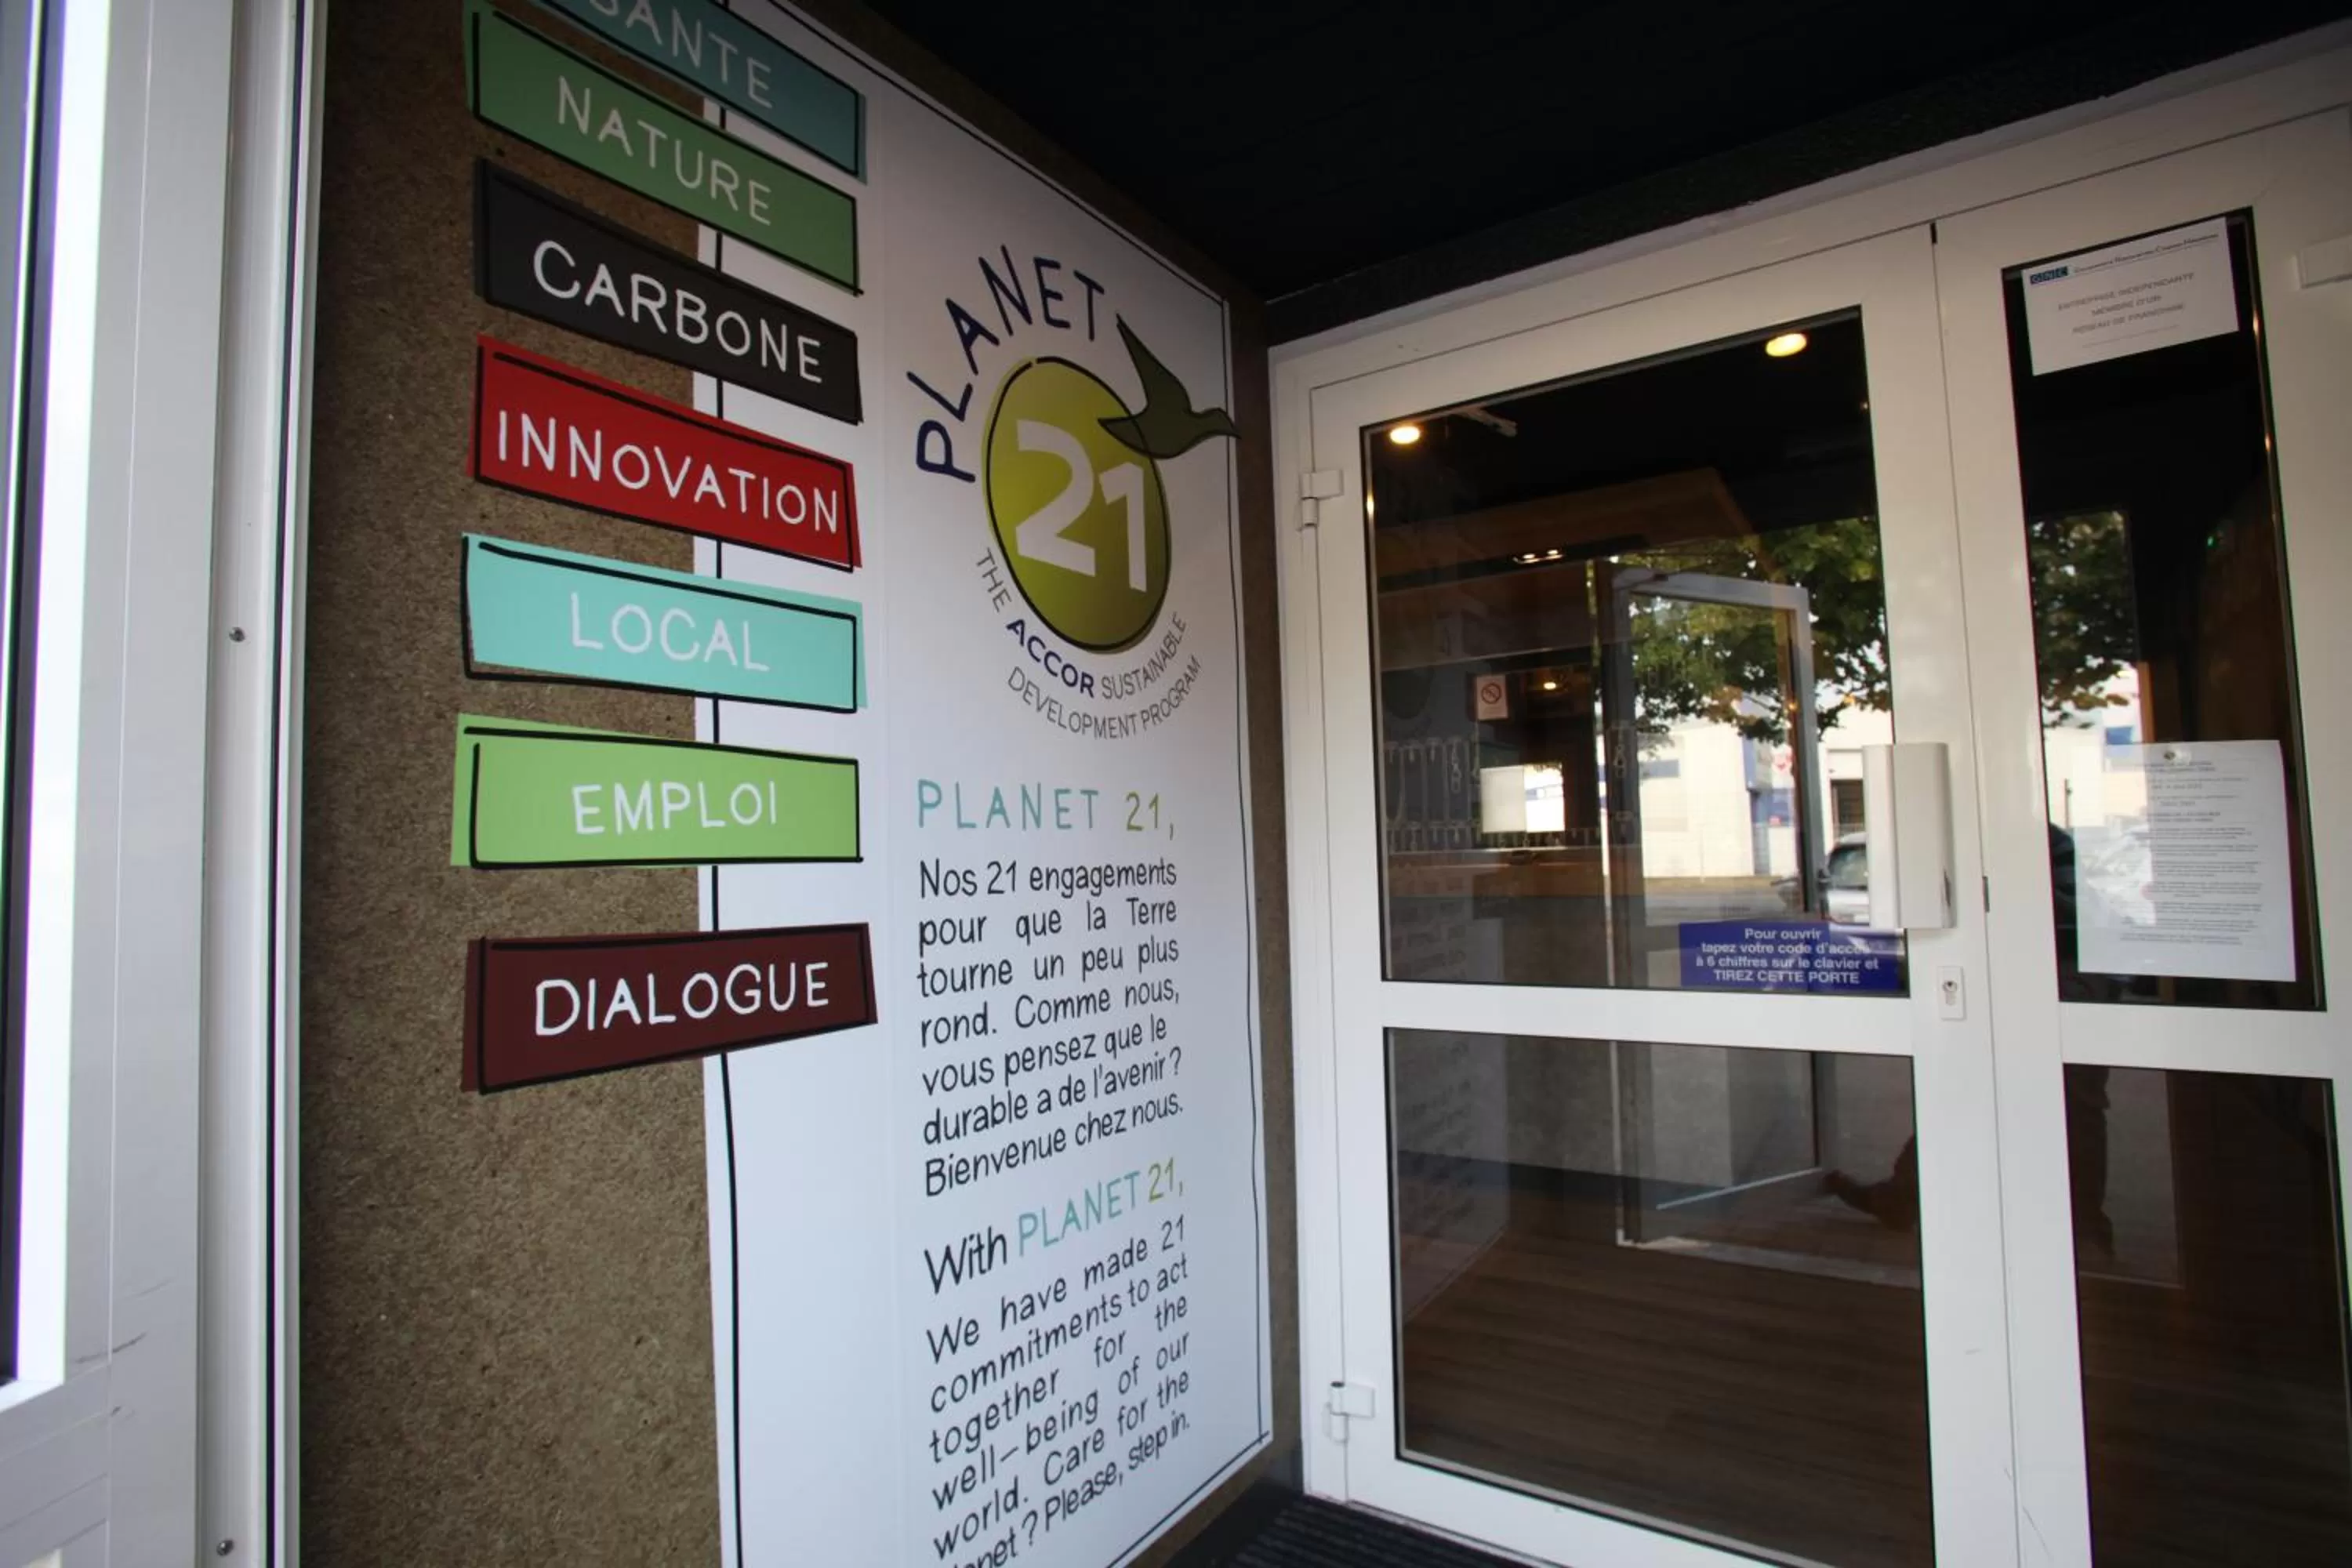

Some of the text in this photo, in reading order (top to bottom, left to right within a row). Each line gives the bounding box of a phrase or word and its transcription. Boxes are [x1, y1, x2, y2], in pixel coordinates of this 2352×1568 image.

[590, 0, 772, 108] ANTE
[558, 75, 771, 226] NATURE
[533, 241, 822, 383] CARBONE
[906, 244, 1105, 483] PLANET
[498, 411, 838, 534] INNOVATION
[1015, 419, 1147, 593] 21
[570, 593, 770, 672] LOCAL
[976, 547, 1186, 699] THE ACCOR SUSTAINABLE
[1007, 655, 1201, 739] DEVELOPMENT PROGRAM
[572, 781, 776, 835] EMPLOI
[917, 779, 1174, 841] PLANET 21,
[920, 857, 1177, 899] Nos 21 engagements
[916, 935, 1179, 997] tourne un peu plus
[919, 897, 1177, 958] pour que la Terre
[1696, 955, 1704, 966] à
[1719, 955, 1768, 967] chiffres
[1772, 957, 1793, 967] sur
[1798, 956, 1810, 968] le
[1814, 956, 1860, 969] clavier
[1864, 957, 1879, 969] et
[1701, 941, 1871, 955] tapez votre code d'acc
[1744, 927, 1821, 940] Pour ouvrir
[535, 962, 829, 1036] DIALOGUE
[920, 978, 1179, 1047] rond. Comme nous,
[1712, 968, 1860, 984] TIREZ CETTE PORTE
[922, 1013, 1167, 1096] vous pensez que le
[923, 1091, 1028, 1145] durable
[1037, 1088, 1051, 1114] a
[1058, 1074, 1086, 1106] de
[925, 1092, 1183, 1196] Bienvenue chez nous.
[924, 1156, 1183, 1295] With PLANET 21,
[926, 1214, 1185, 1365] We have made 21
[931, 1253, 1189, 1414] commitments to act
[1119, 1356, 1139, 1395] of
[1156, 1332, 1189, 1370] our
[929, 1295, 1188, 1463] together for the
[934, 1370, 1189, 1560] world. Care for the
[1045, 1461, 1123, 1532] Please,
[1128, 1425, 1167, 1470] step
[1171, 1410, 1189, 1438] in.
